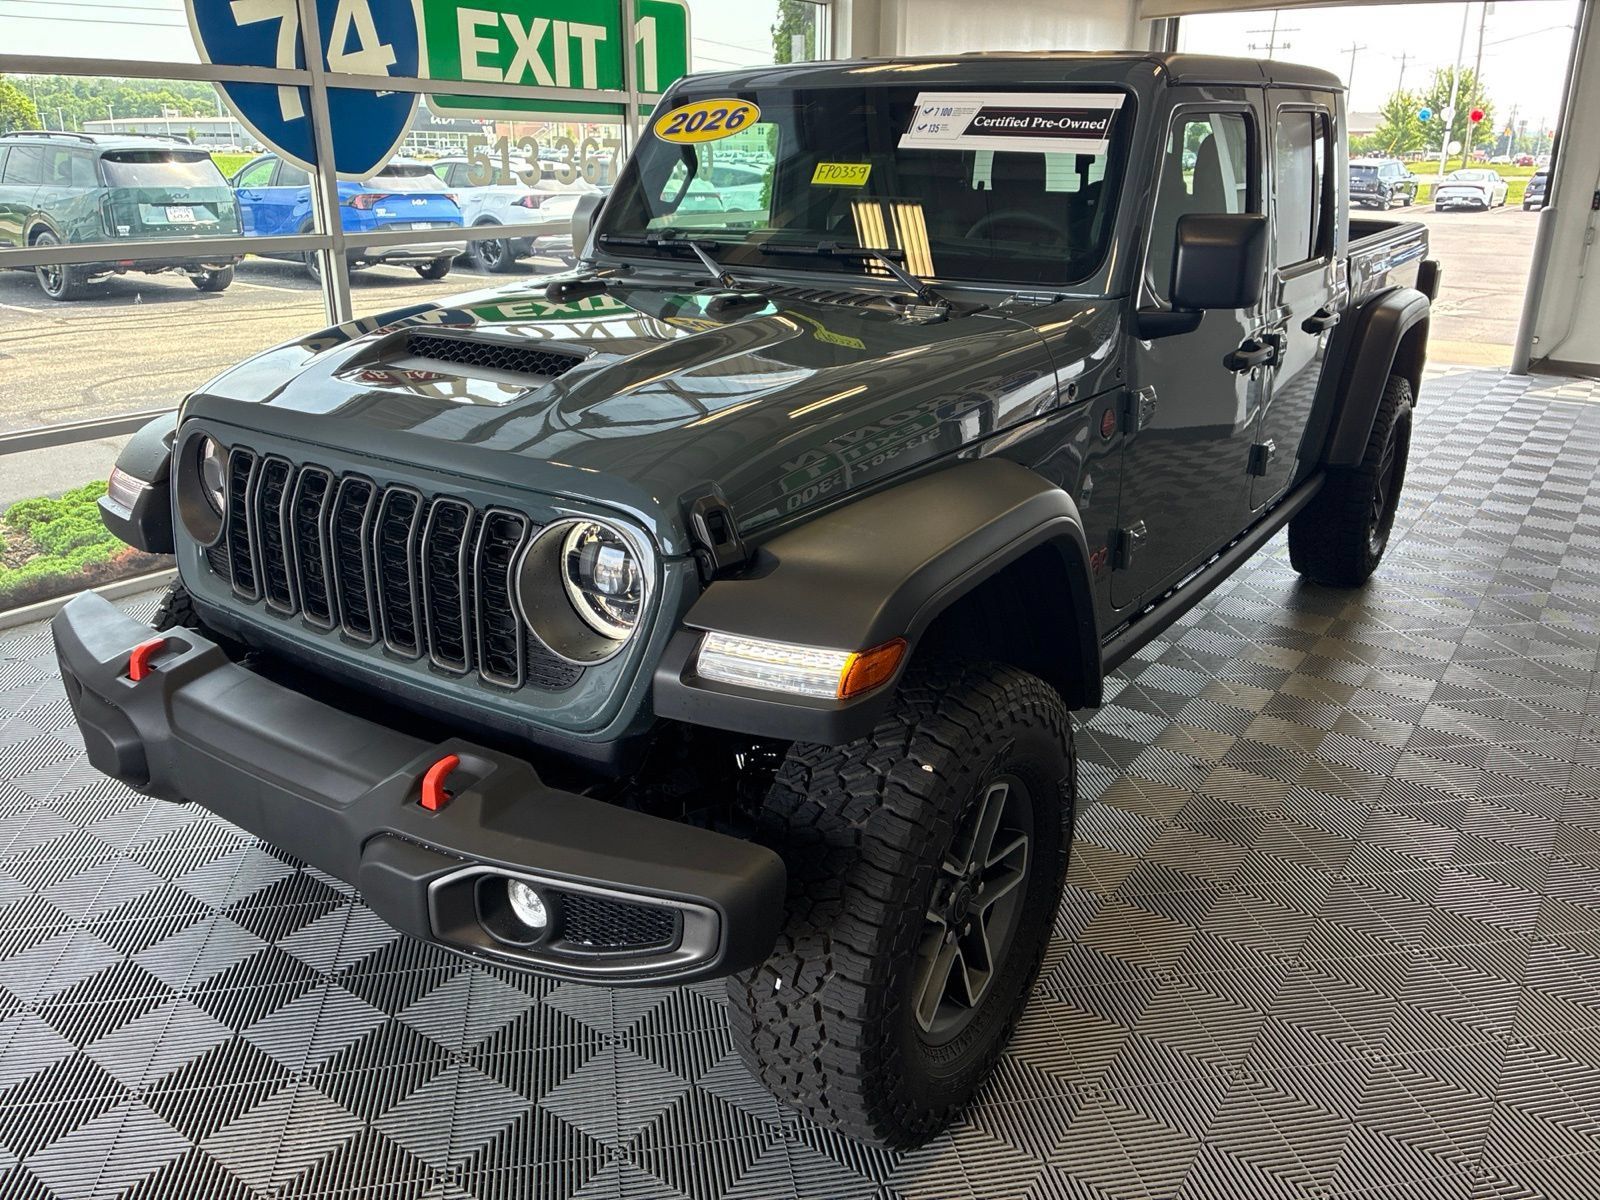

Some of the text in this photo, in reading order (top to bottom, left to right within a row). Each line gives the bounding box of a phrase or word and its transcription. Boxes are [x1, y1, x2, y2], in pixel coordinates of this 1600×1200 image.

[230, 0, 397, 122] 74
[456, 7, 658, 92] EXIT 1
[663, 107, 749, 136] 2026
[973, 116, 1107, 130] Certified Pre-Owned
